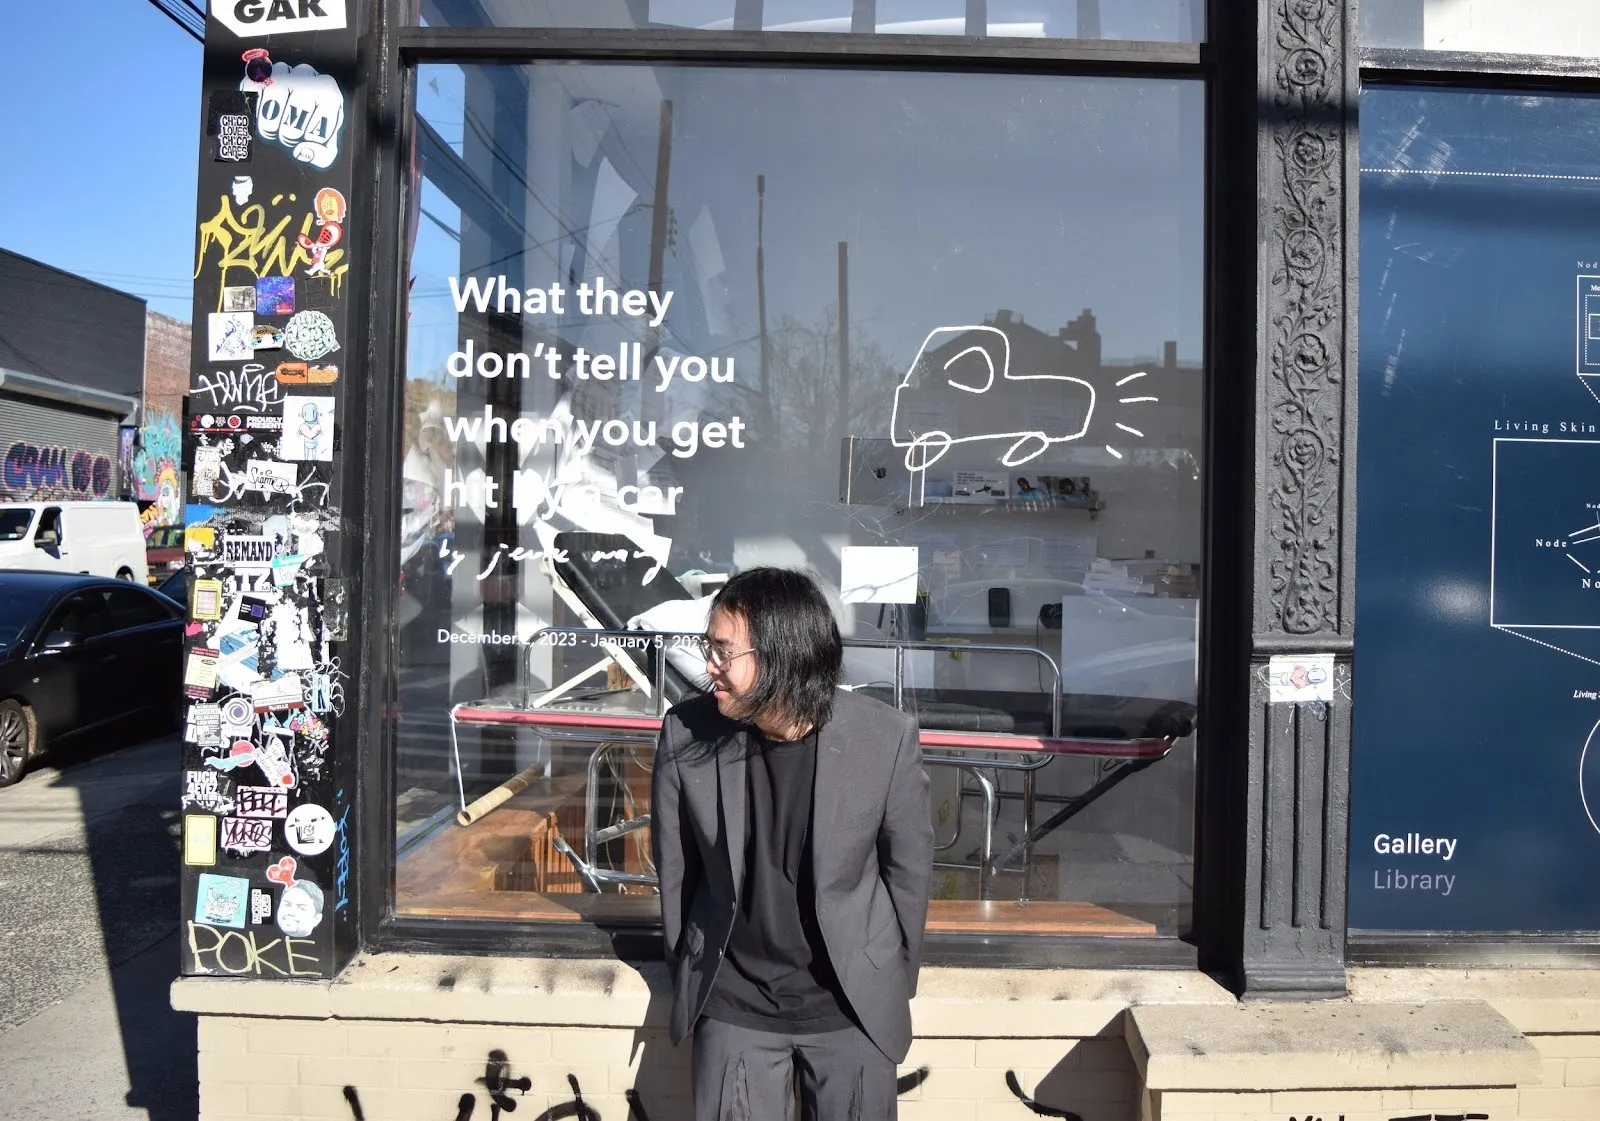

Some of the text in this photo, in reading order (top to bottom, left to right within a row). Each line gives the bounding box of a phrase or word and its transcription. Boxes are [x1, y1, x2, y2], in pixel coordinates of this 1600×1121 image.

[222, 126, 248, 136] LOVES
[221, 145, 248, 159] CARES
[448, 275, 674, 327] What they
[447, 339, 735, 393] don’t tell you
[246, 416, 283, 424] PROUDLY
[1494, 420, 1596, 434] Living Skin
[444, 404, 745, 459] when you get
[617, 485, 684, 516] car
[226, 541, 273, 562] REMAND
[1535, 538, 1567, 548] Node
[439, 539, 466, 575] by
[437, 629, 518, 644] December
[540, 632, 577, 647] 2023
[590, 633, 650, 651] January
[654, 634, 667, 651] 5,
[672, 635, 709, 650] 202
[1573, 690, 1597, 700] Living
[186, 771, 217, 783] FUCK
[1374, 832, 1457, 861] Gallery
[1374, 869, 1456, 896] Library
[187, 920, 323, 975] POKE
